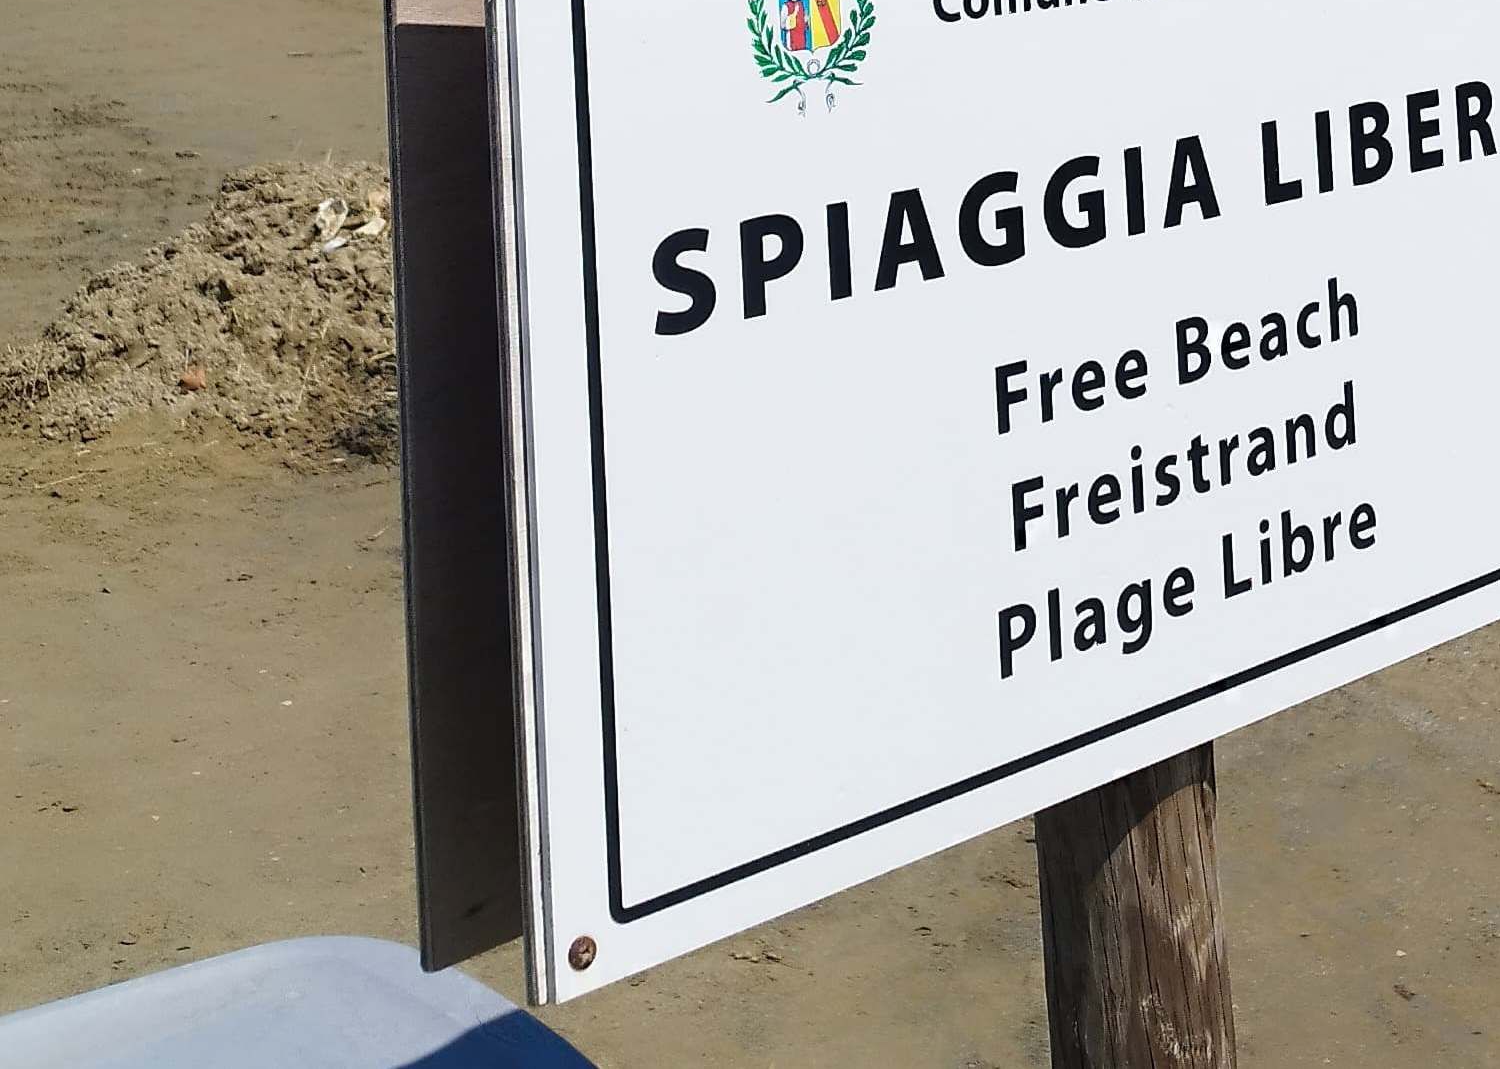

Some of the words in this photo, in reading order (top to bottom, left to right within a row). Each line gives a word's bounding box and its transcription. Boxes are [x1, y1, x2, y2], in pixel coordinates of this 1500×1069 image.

[652, 134, 1221, 336] SPIAGGIA
[994, 349, 1148, 436] Free
[1175, 276, 1359, 386] Beach
[1011, 379, 1357, 553] Freistrand
[998, 566, 1195, 680] Plage
[1222, 502, 1377, 600] Libre
